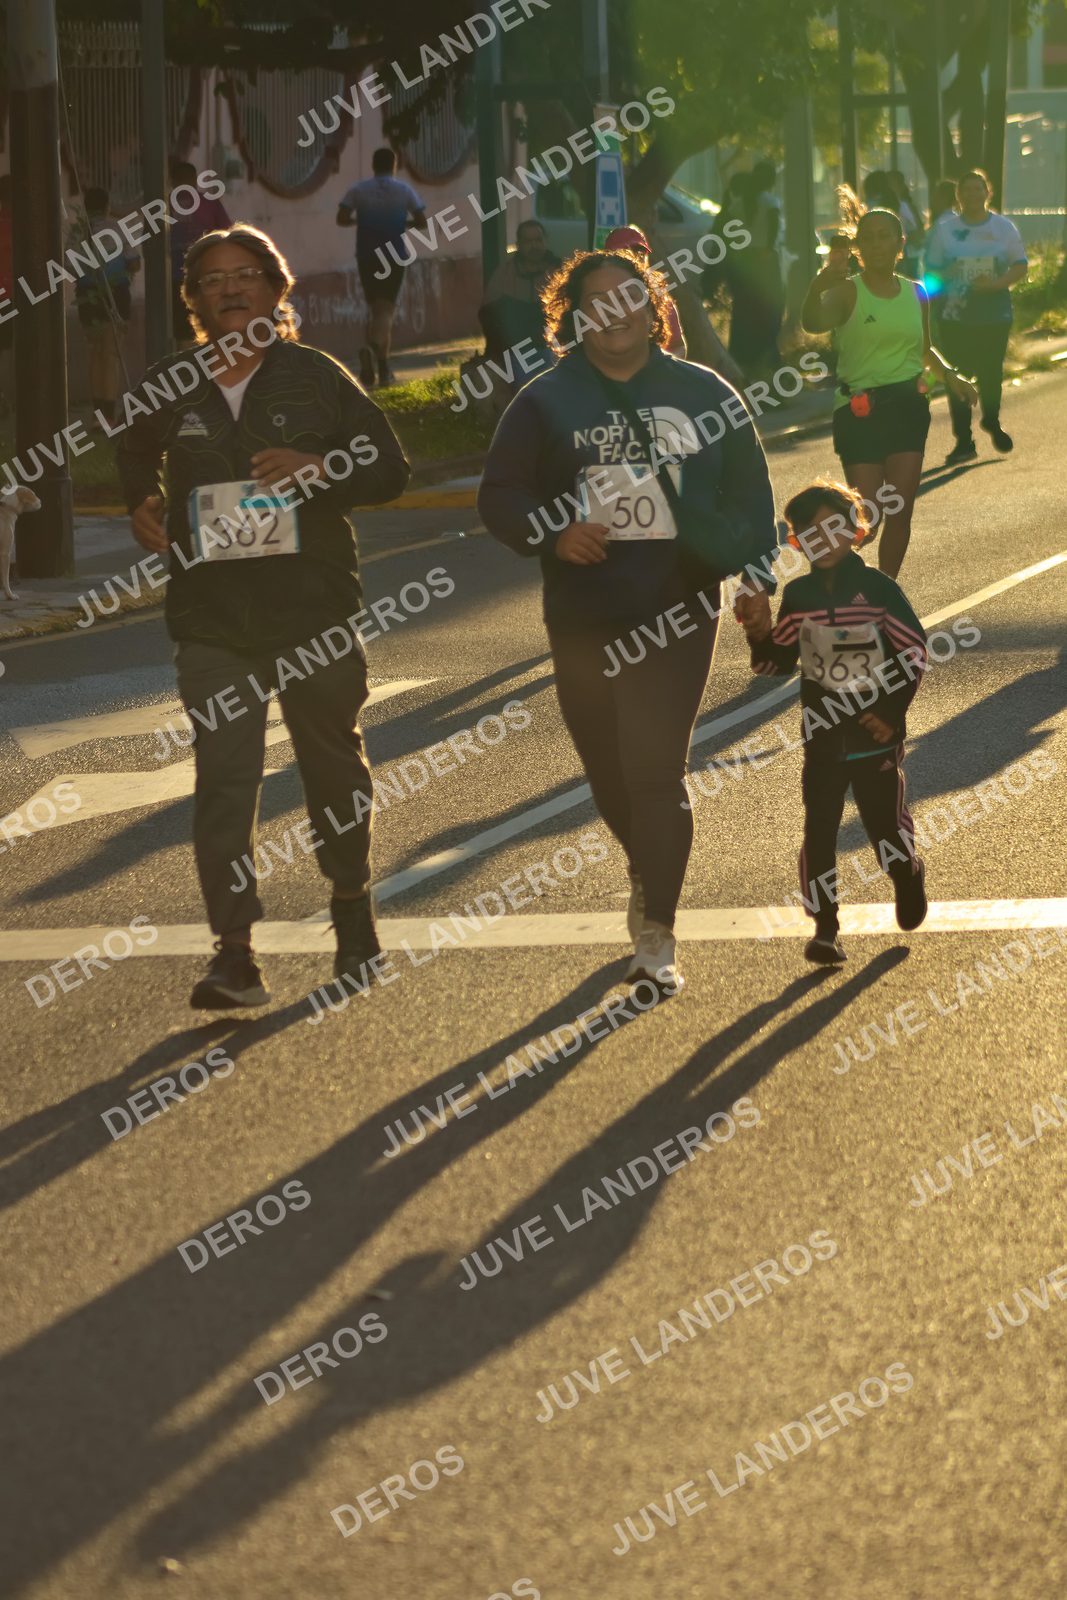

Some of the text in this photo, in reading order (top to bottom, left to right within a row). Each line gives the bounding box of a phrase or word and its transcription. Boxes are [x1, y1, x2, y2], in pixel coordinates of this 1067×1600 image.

[606, 408, 653, 425] TE
[599, 441, 647, 464] FAC
[612, 495, 656, 529] 50
[812, 651, 871, 682] 363
